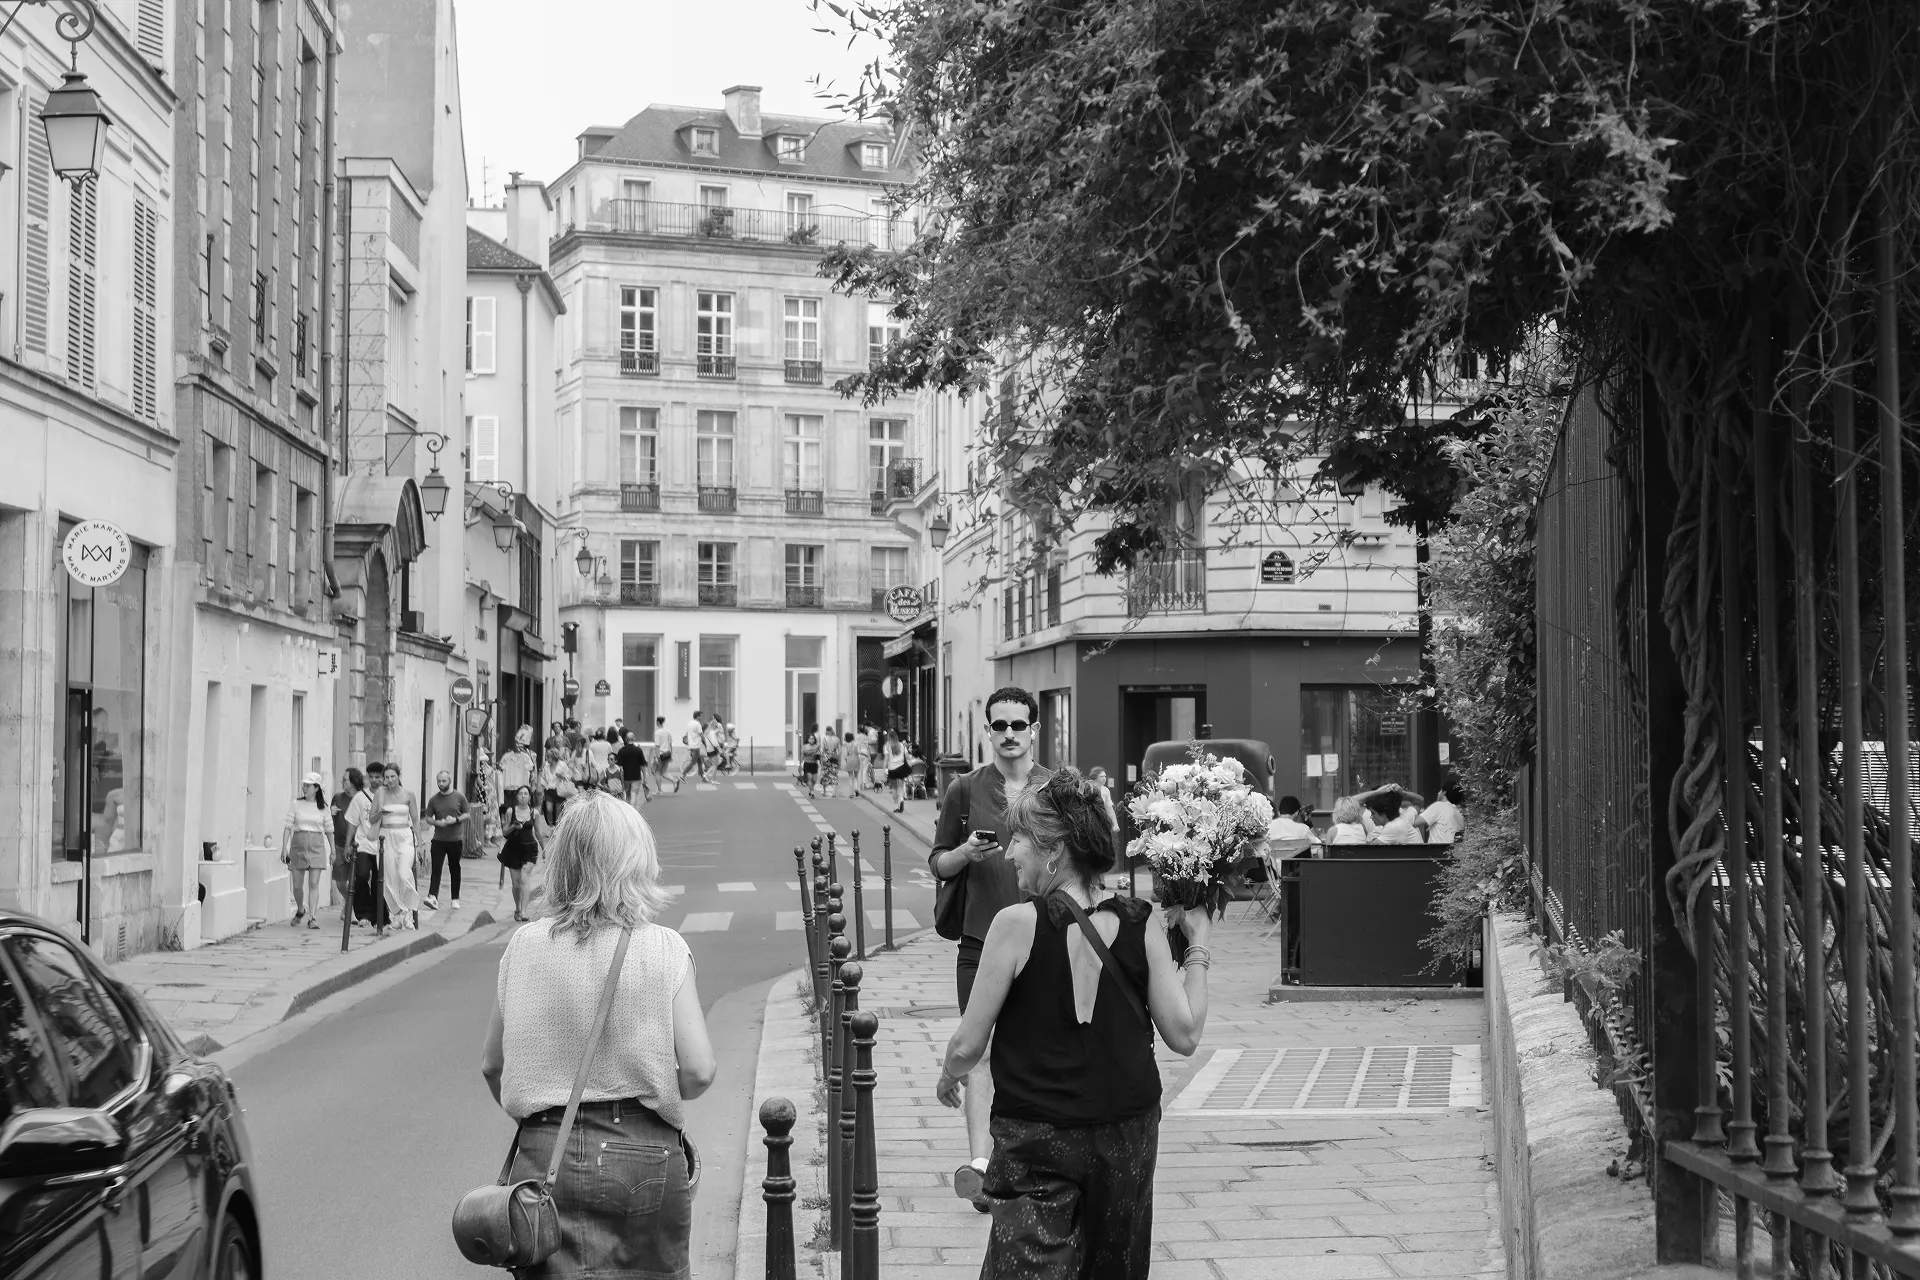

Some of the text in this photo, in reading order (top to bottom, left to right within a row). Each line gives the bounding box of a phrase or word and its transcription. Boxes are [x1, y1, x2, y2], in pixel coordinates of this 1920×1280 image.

[67, 523, 127, 553] MARIE MARTENS
[67, 556, 126, 582] MARIE MARTENS
[897, 598, 911, 606] des
